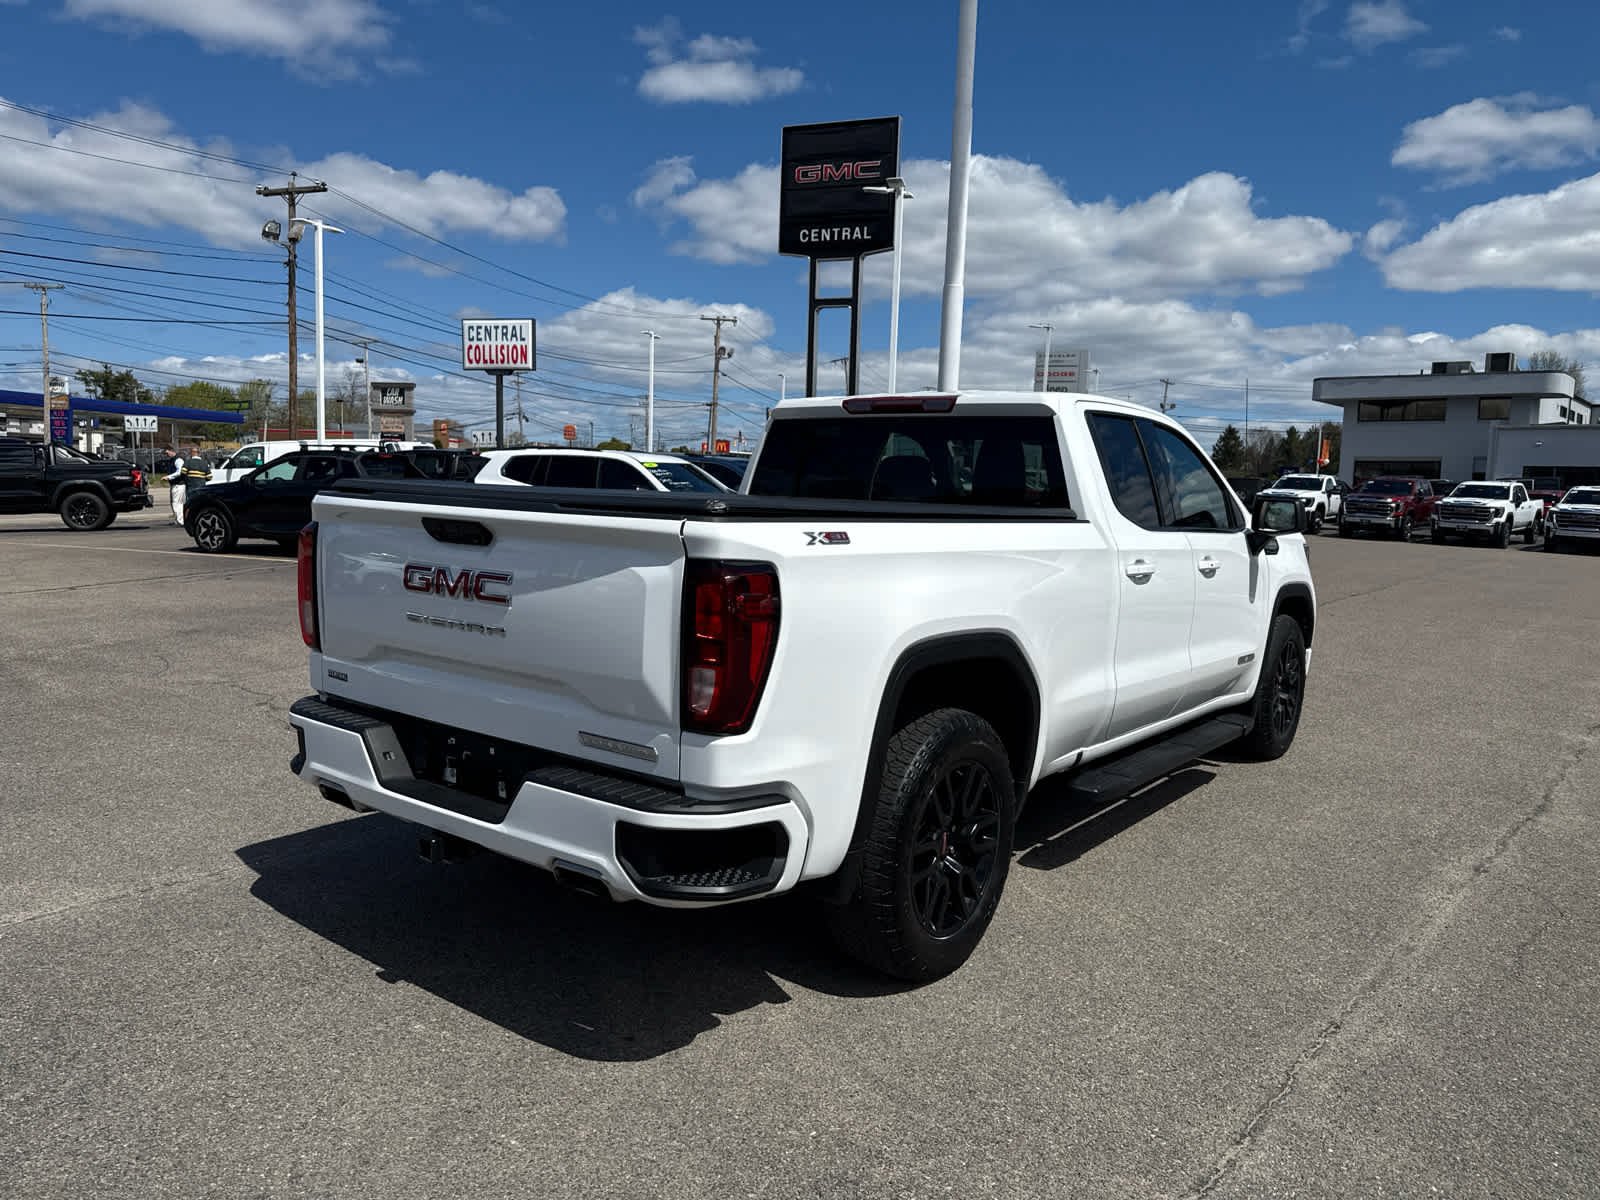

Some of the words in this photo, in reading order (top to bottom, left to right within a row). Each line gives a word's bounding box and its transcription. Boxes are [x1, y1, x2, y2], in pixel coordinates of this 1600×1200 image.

[795, 160, 881, 184] GMC
[799, 226, 872, 243] CENTRAL
[467, 324, 526, 342] CENTRAL
[466, 343, 528, 365] COLLISION
[383, 396, 404, 406] WASH
[403, 563, 513, 608] GMC
